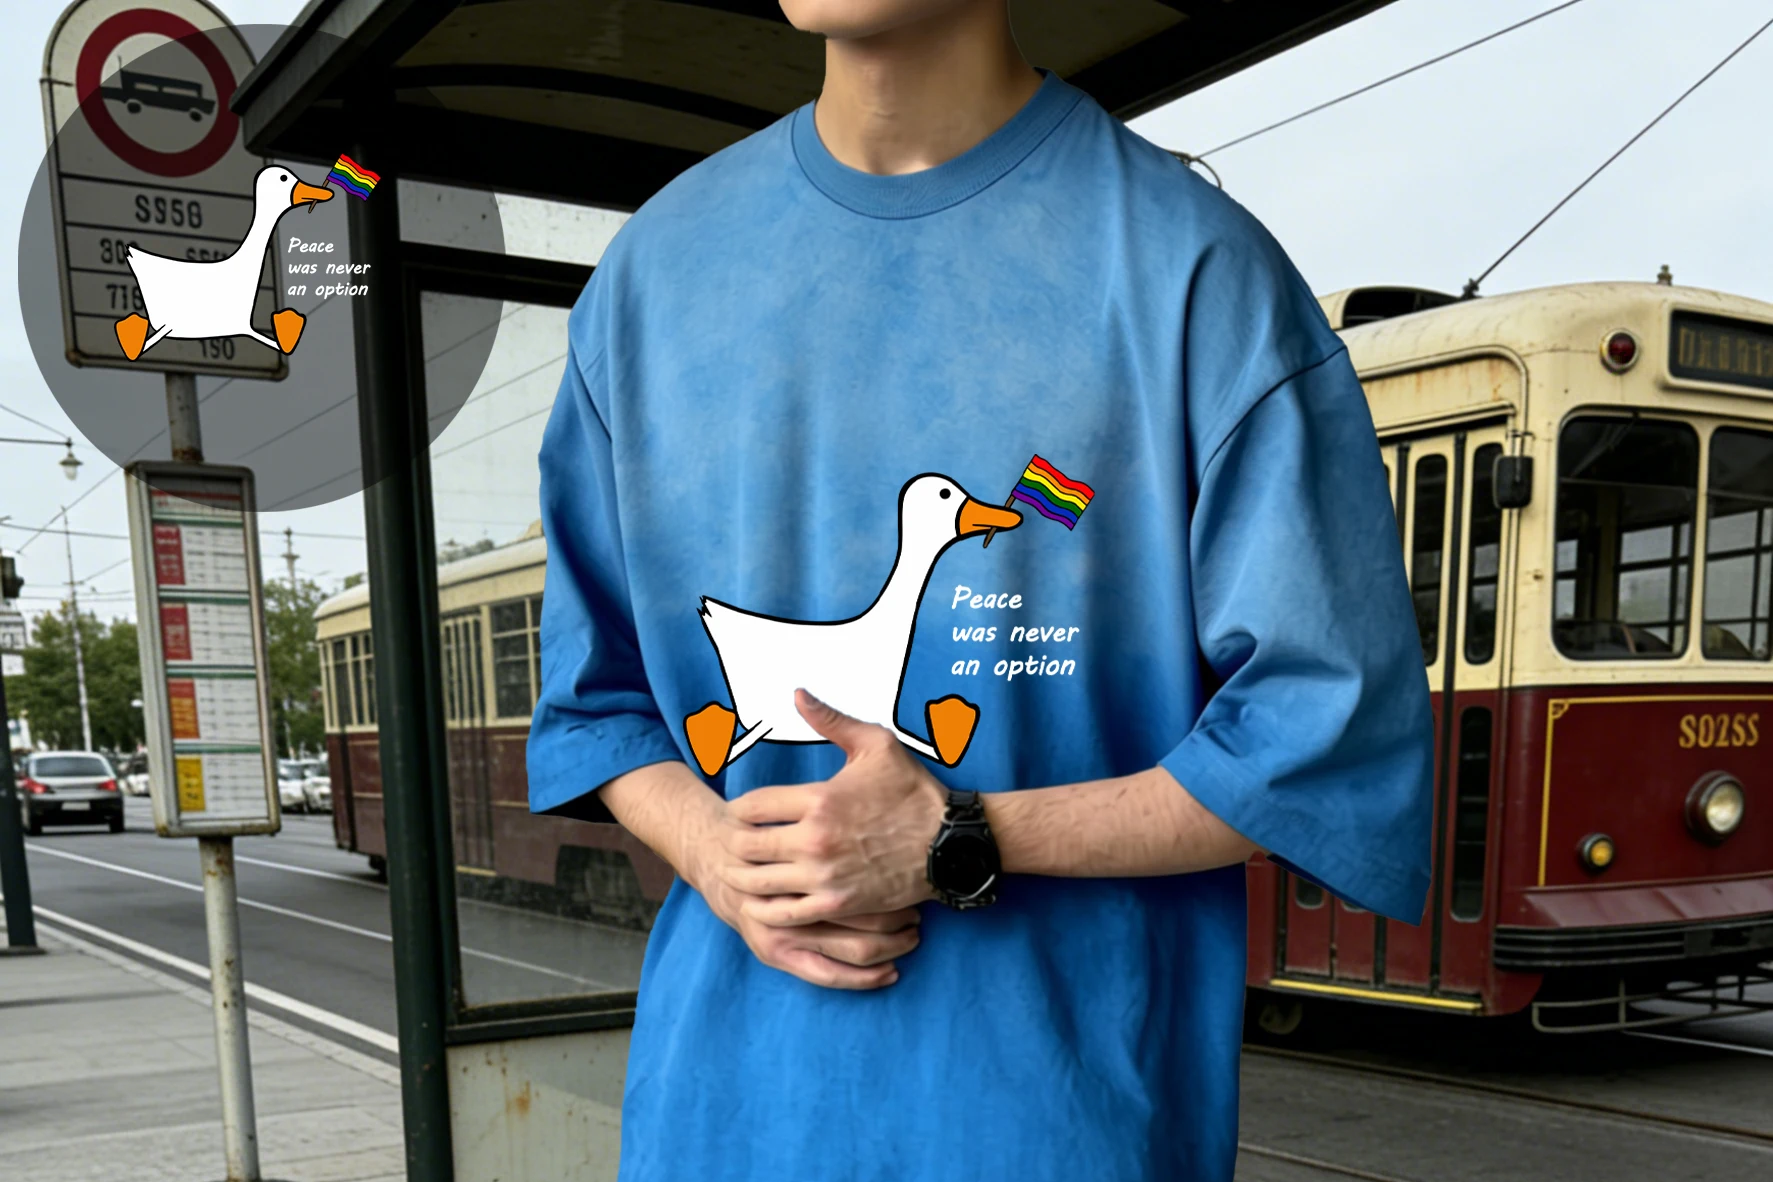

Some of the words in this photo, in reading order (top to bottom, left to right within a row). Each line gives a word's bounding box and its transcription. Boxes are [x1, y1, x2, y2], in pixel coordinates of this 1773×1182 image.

[951, 584, 1024, 610] Peace
[952, 626, 998, 642] was
[1010, 626, 1080, 643] never
[951, 658, 980, 676] an
[993, 655, 1076, 682] option
